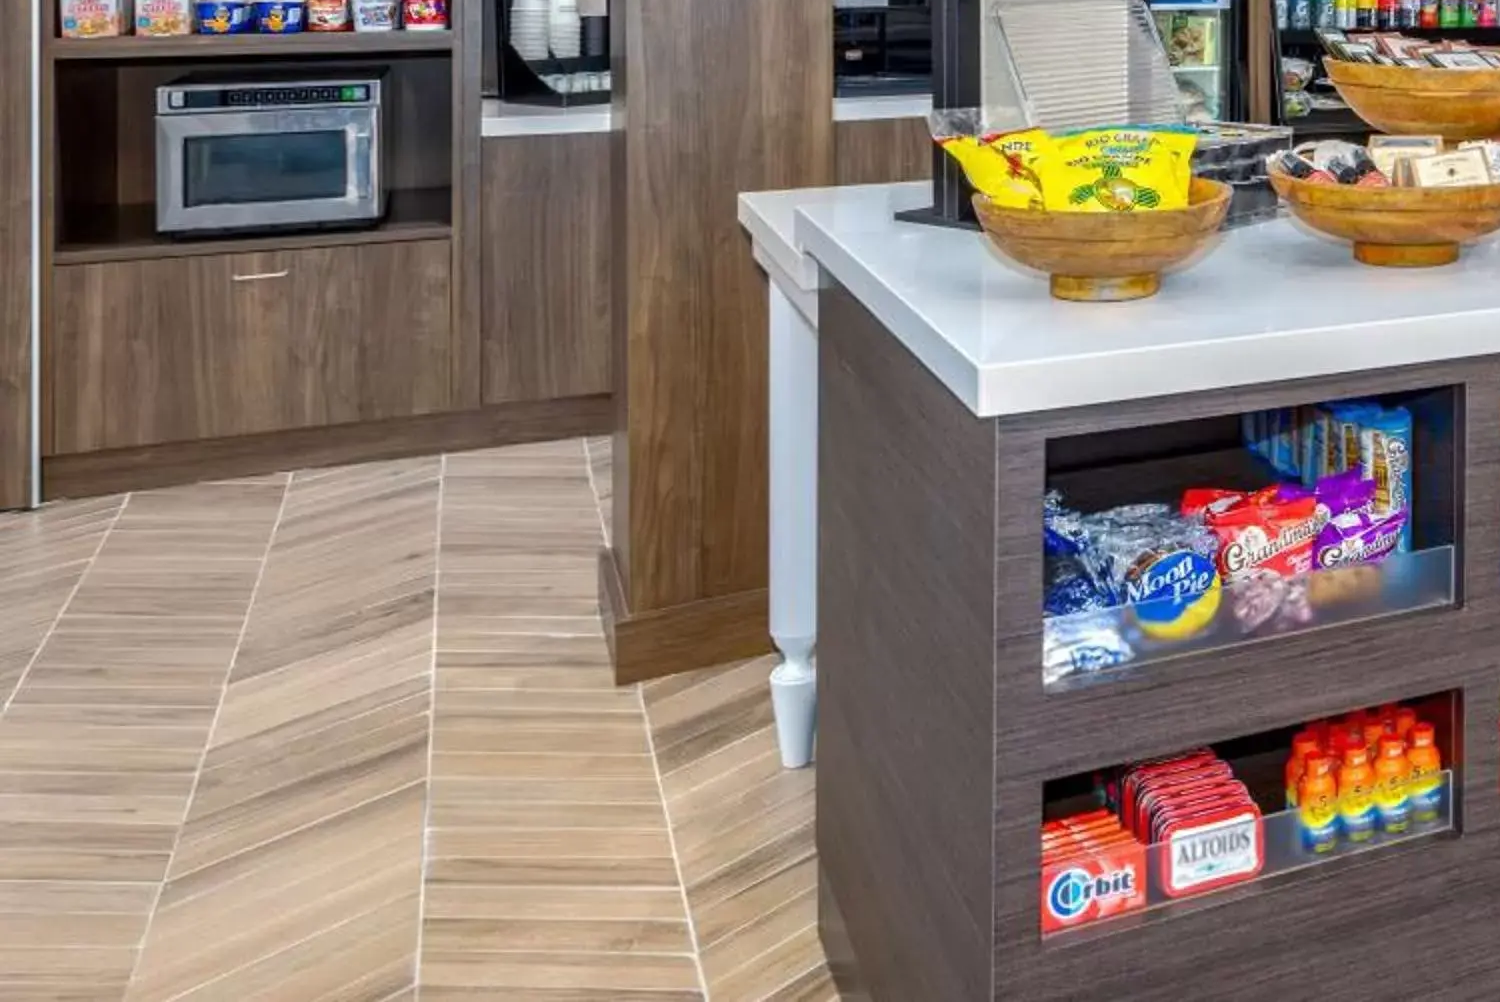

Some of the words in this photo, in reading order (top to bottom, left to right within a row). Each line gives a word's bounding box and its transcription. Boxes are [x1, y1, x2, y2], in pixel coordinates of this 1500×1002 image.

[1127, 556, 1194, 603] Moon
[1173, 571, 1210, 606] Pie
[1177, 830, 1251, 865] ALTOIDS
[1047, 864, 1136, 920] Orbit
